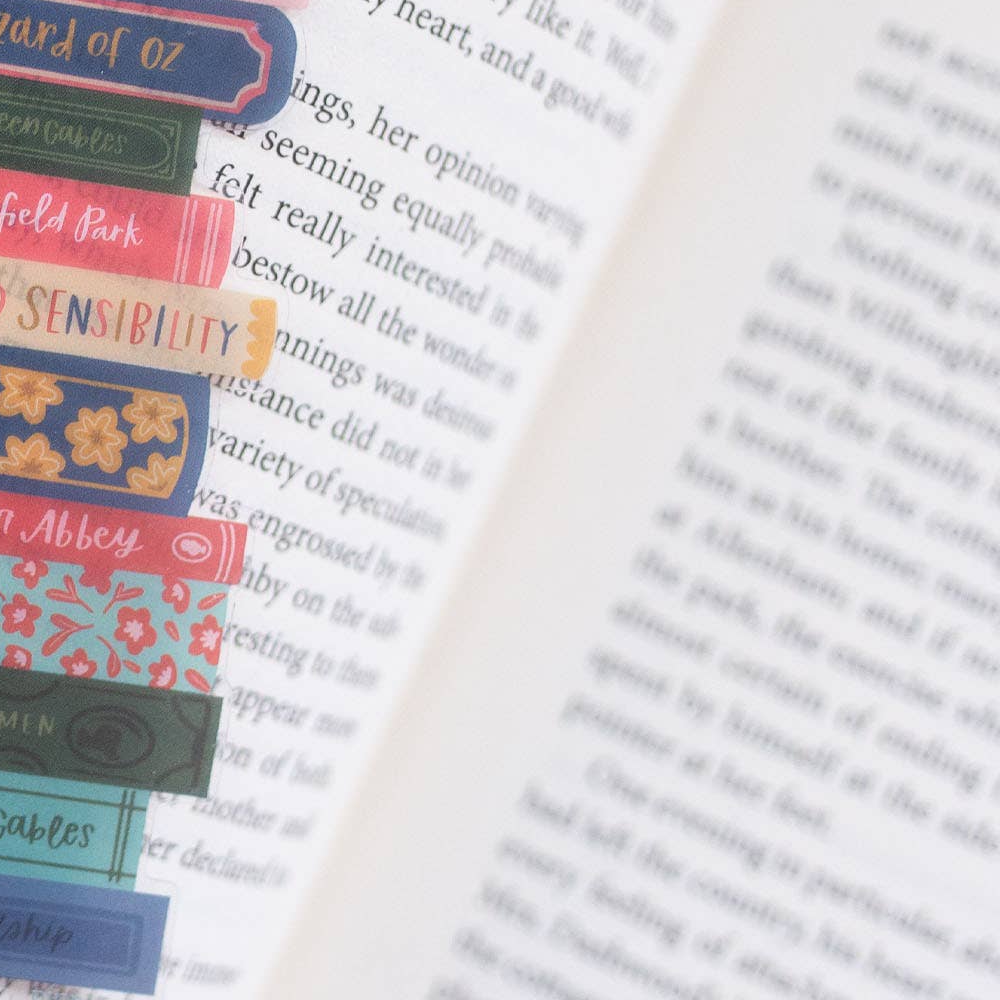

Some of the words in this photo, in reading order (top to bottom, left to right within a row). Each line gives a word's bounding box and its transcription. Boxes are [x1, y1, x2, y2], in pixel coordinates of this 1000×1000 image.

[87, 27, 131, 71] of
[479, 39, 531, 90] and
[260, 129, 386, 211] seeming
[368, 105, 420, 153] her
[424, 142, 520, 204] opinion
[74, 212, 144, 248] Park
[271, 199, 357, 259] really
[232, 235, 335, 305] bestow
[337, 290, 376, 326] all
[17, 285, 239, 356] SENSIBILITY
[208, 425, 304, 490] variety
[20, 507, 144, 557] Abbey
